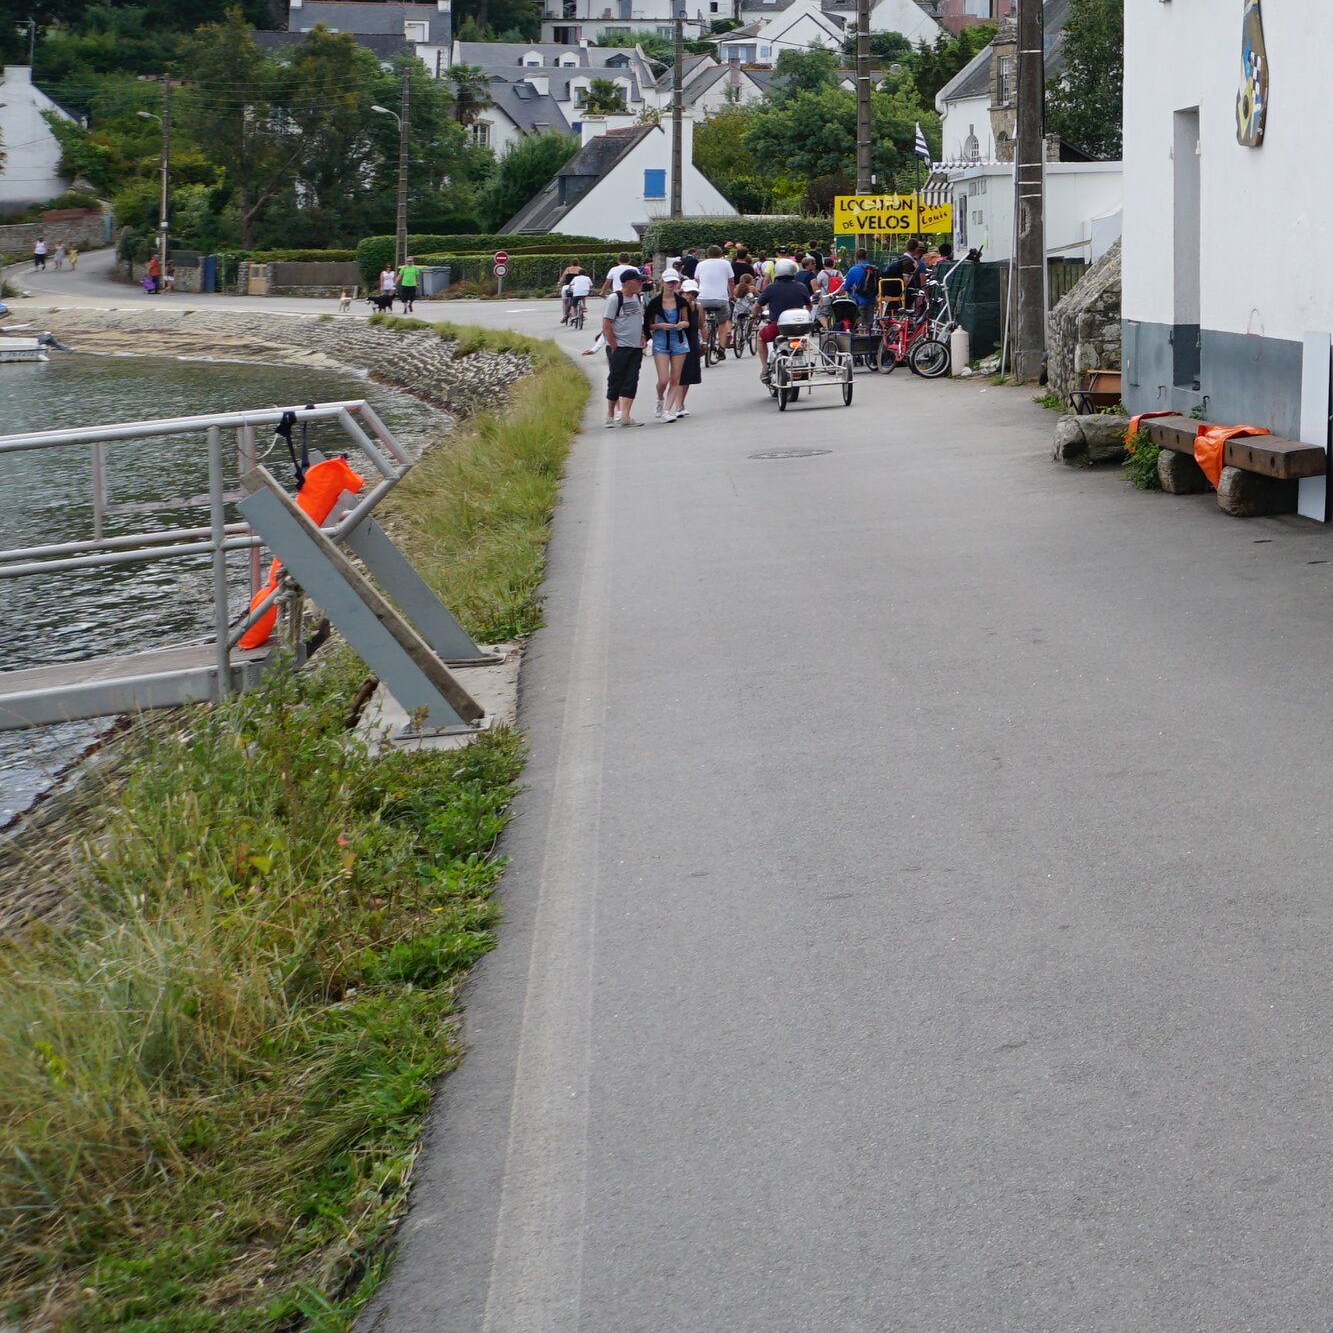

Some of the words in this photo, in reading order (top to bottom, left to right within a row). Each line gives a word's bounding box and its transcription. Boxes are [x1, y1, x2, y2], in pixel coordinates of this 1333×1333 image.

[842, 219, 855, 230] DE
[856, 215, 911, 230] VELOS
[921, 211, 948, 225] Louis
